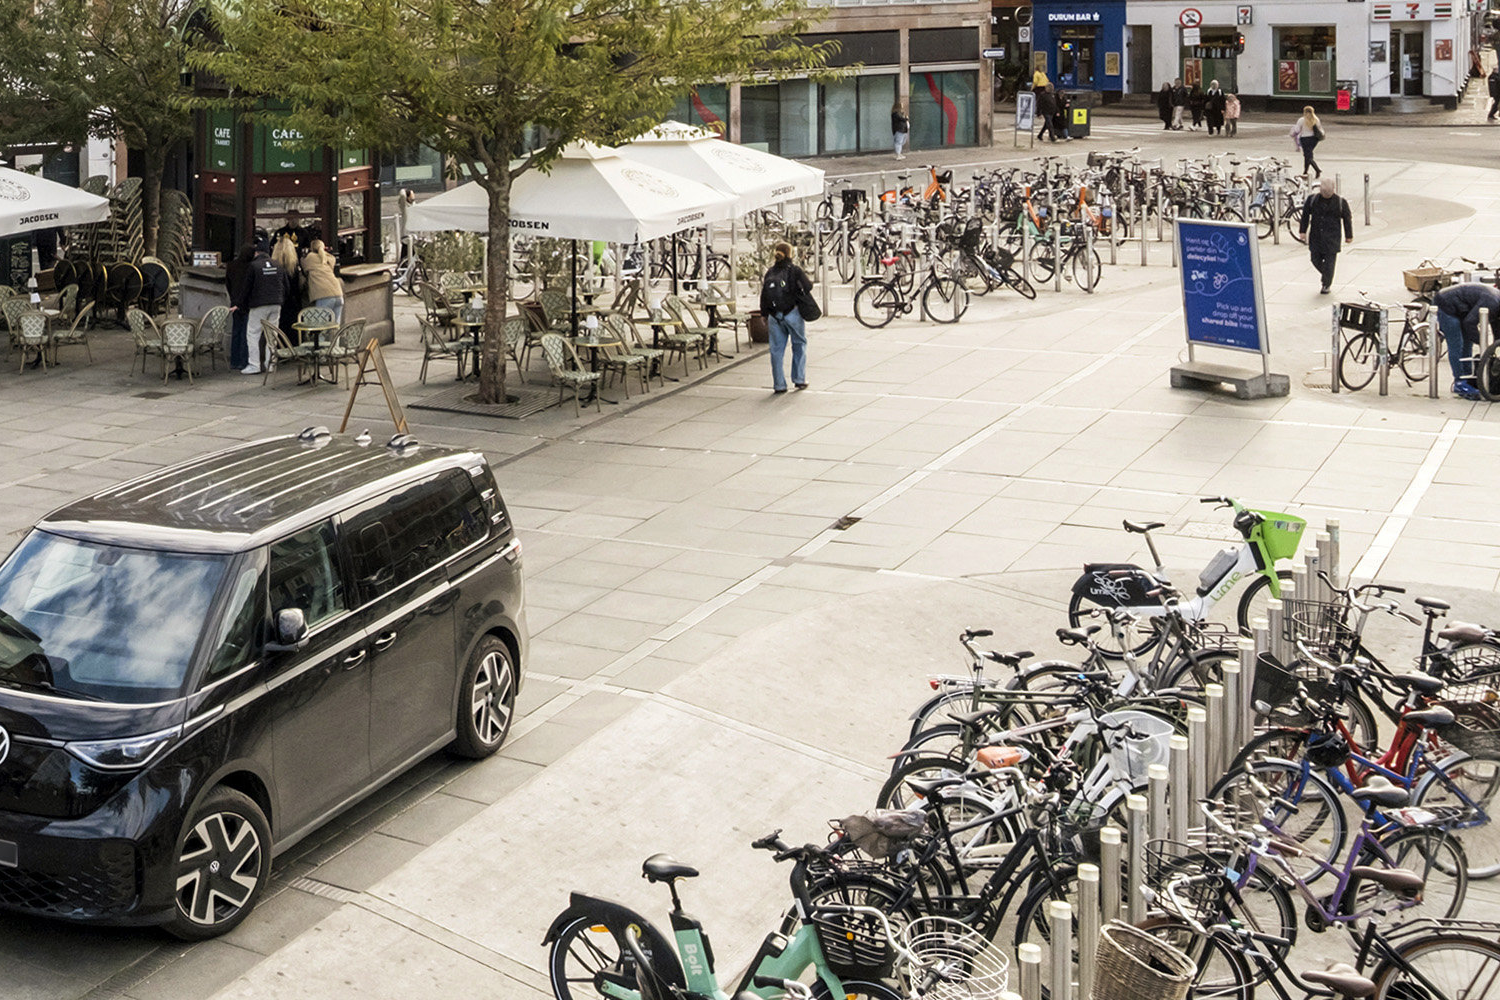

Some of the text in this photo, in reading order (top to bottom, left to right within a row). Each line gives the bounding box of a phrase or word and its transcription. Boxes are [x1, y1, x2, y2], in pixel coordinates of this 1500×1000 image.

[1075, 13, 1091, 21] BAR
[214, 128, 231, 139] CAFE
[19, 212, 60, 226] JACOBSEN
[508, 219, 550, 230] OBSEN
[1209, 571, 1242, 602] Lime
